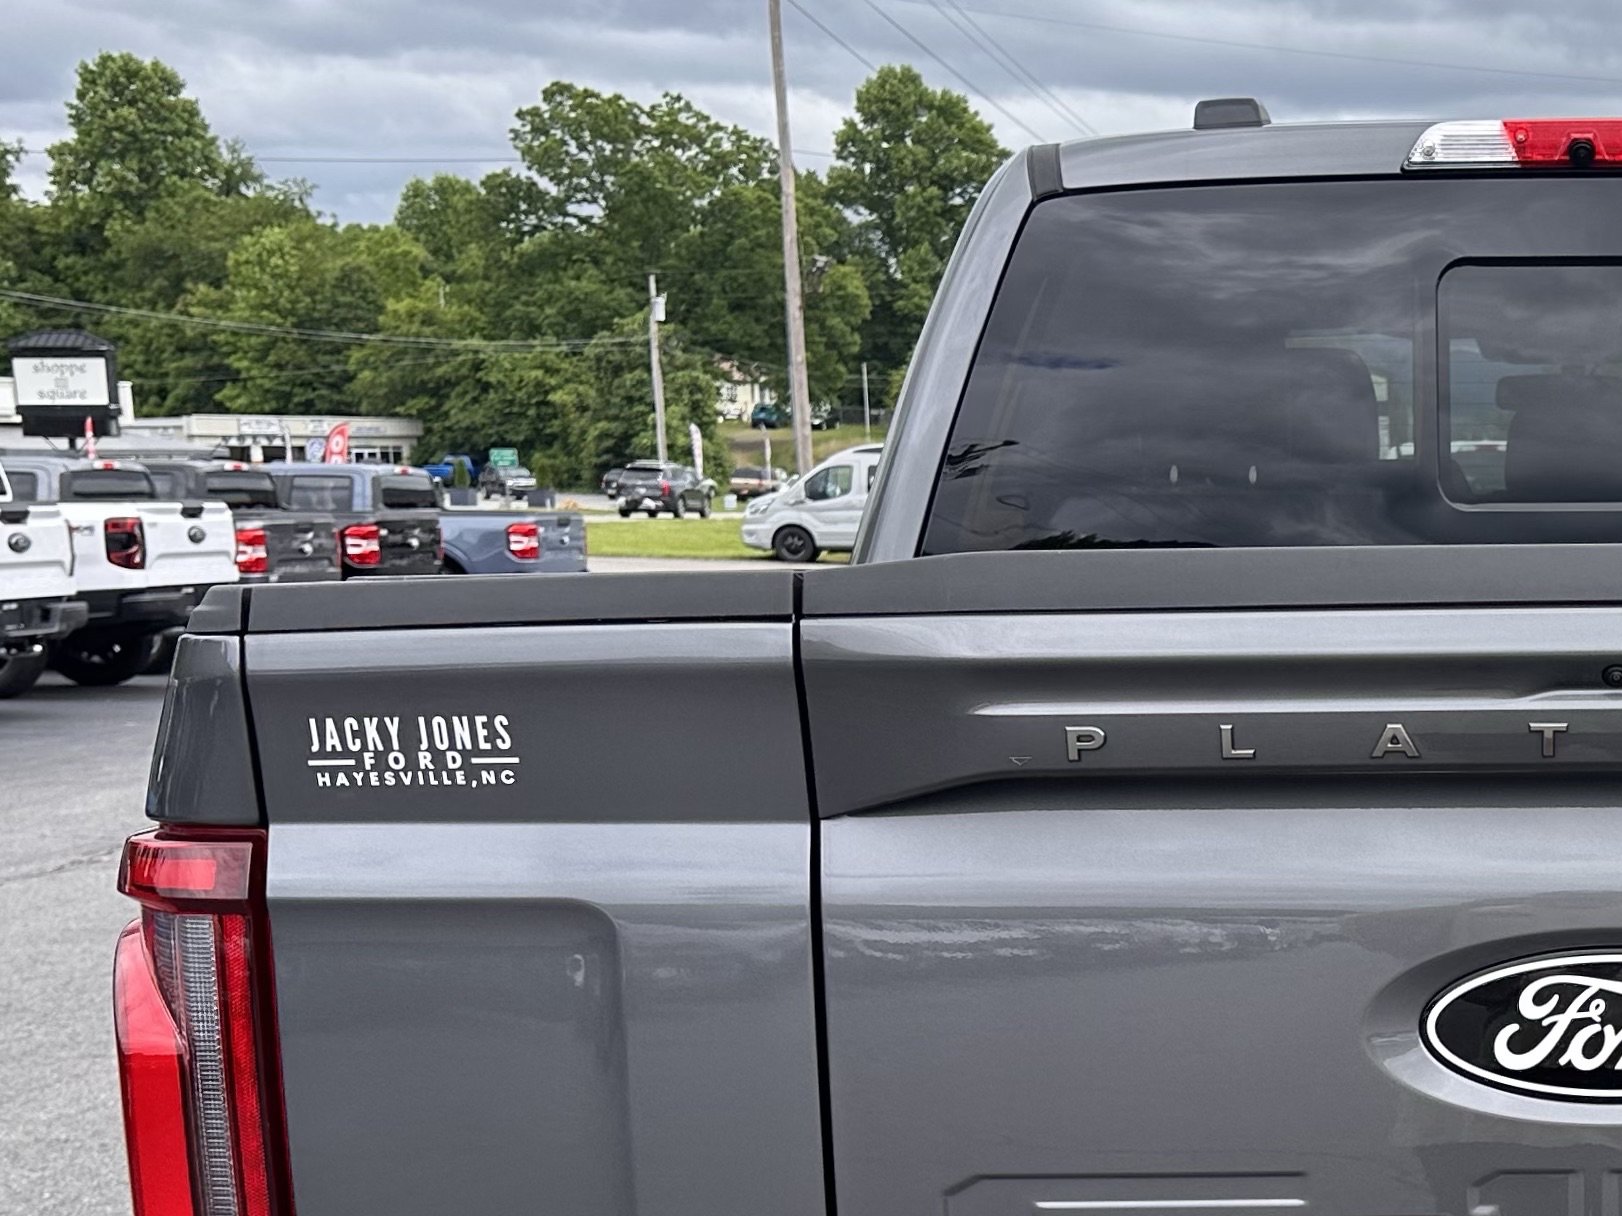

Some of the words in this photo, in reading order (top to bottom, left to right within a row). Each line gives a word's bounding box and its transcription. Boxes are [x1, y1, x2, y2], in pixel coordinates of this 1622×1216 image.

[308, 716, 400, 752] JACKY
[417, 714, 512, 751] JONES
[363, 751, 463, 770] FORD
